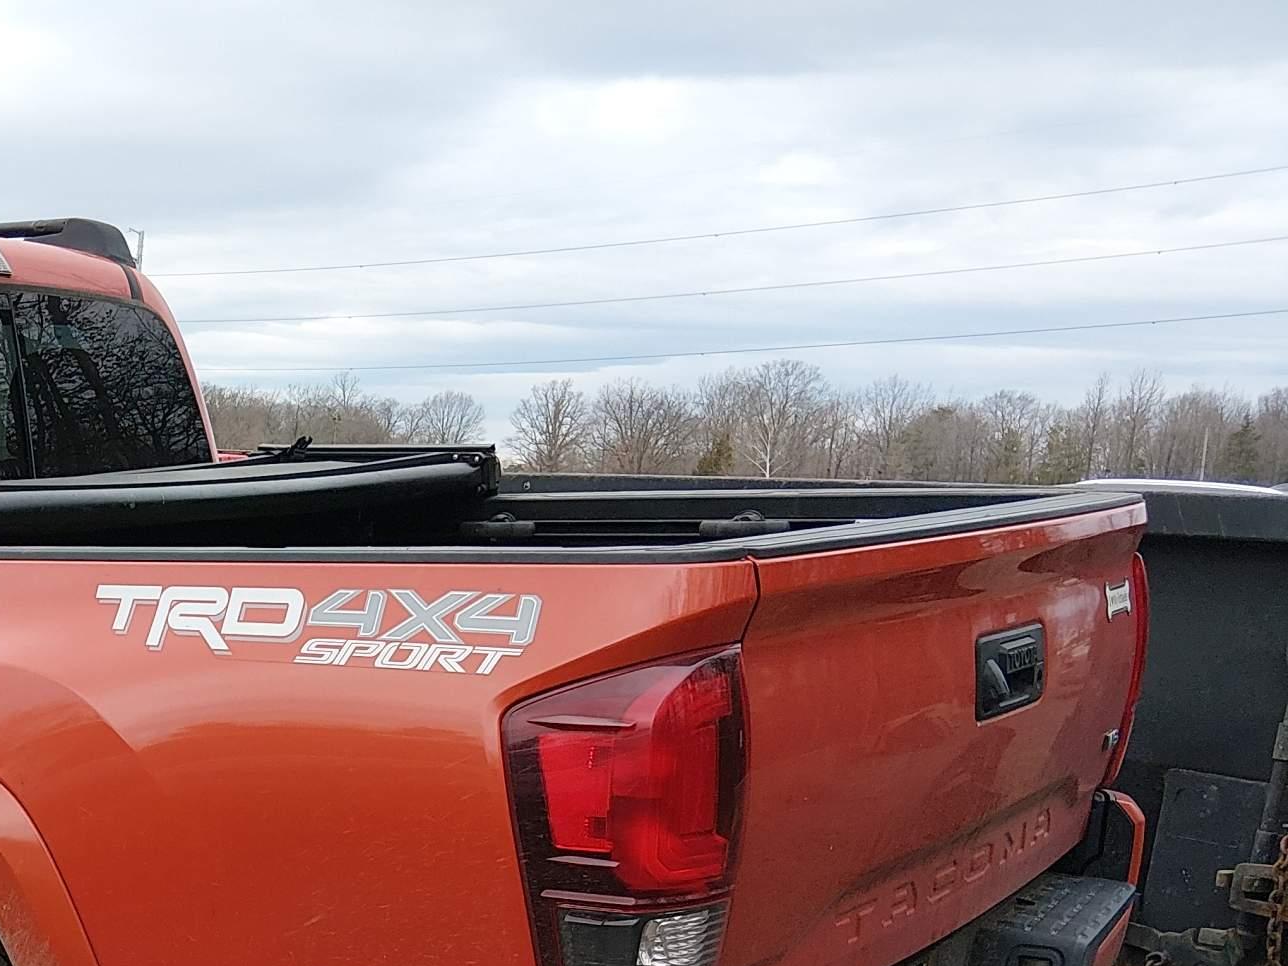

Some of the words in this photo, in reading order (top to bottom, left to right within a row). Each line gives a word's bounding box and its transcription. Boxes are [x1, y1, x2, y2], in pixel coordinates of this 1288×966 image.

[95, 584, 307, 656] TRD
[306, 587, 542, 647] 4X4
[293, 637, 524, 676] SPORT
[832, 806, 1052, 946] TACOMA
